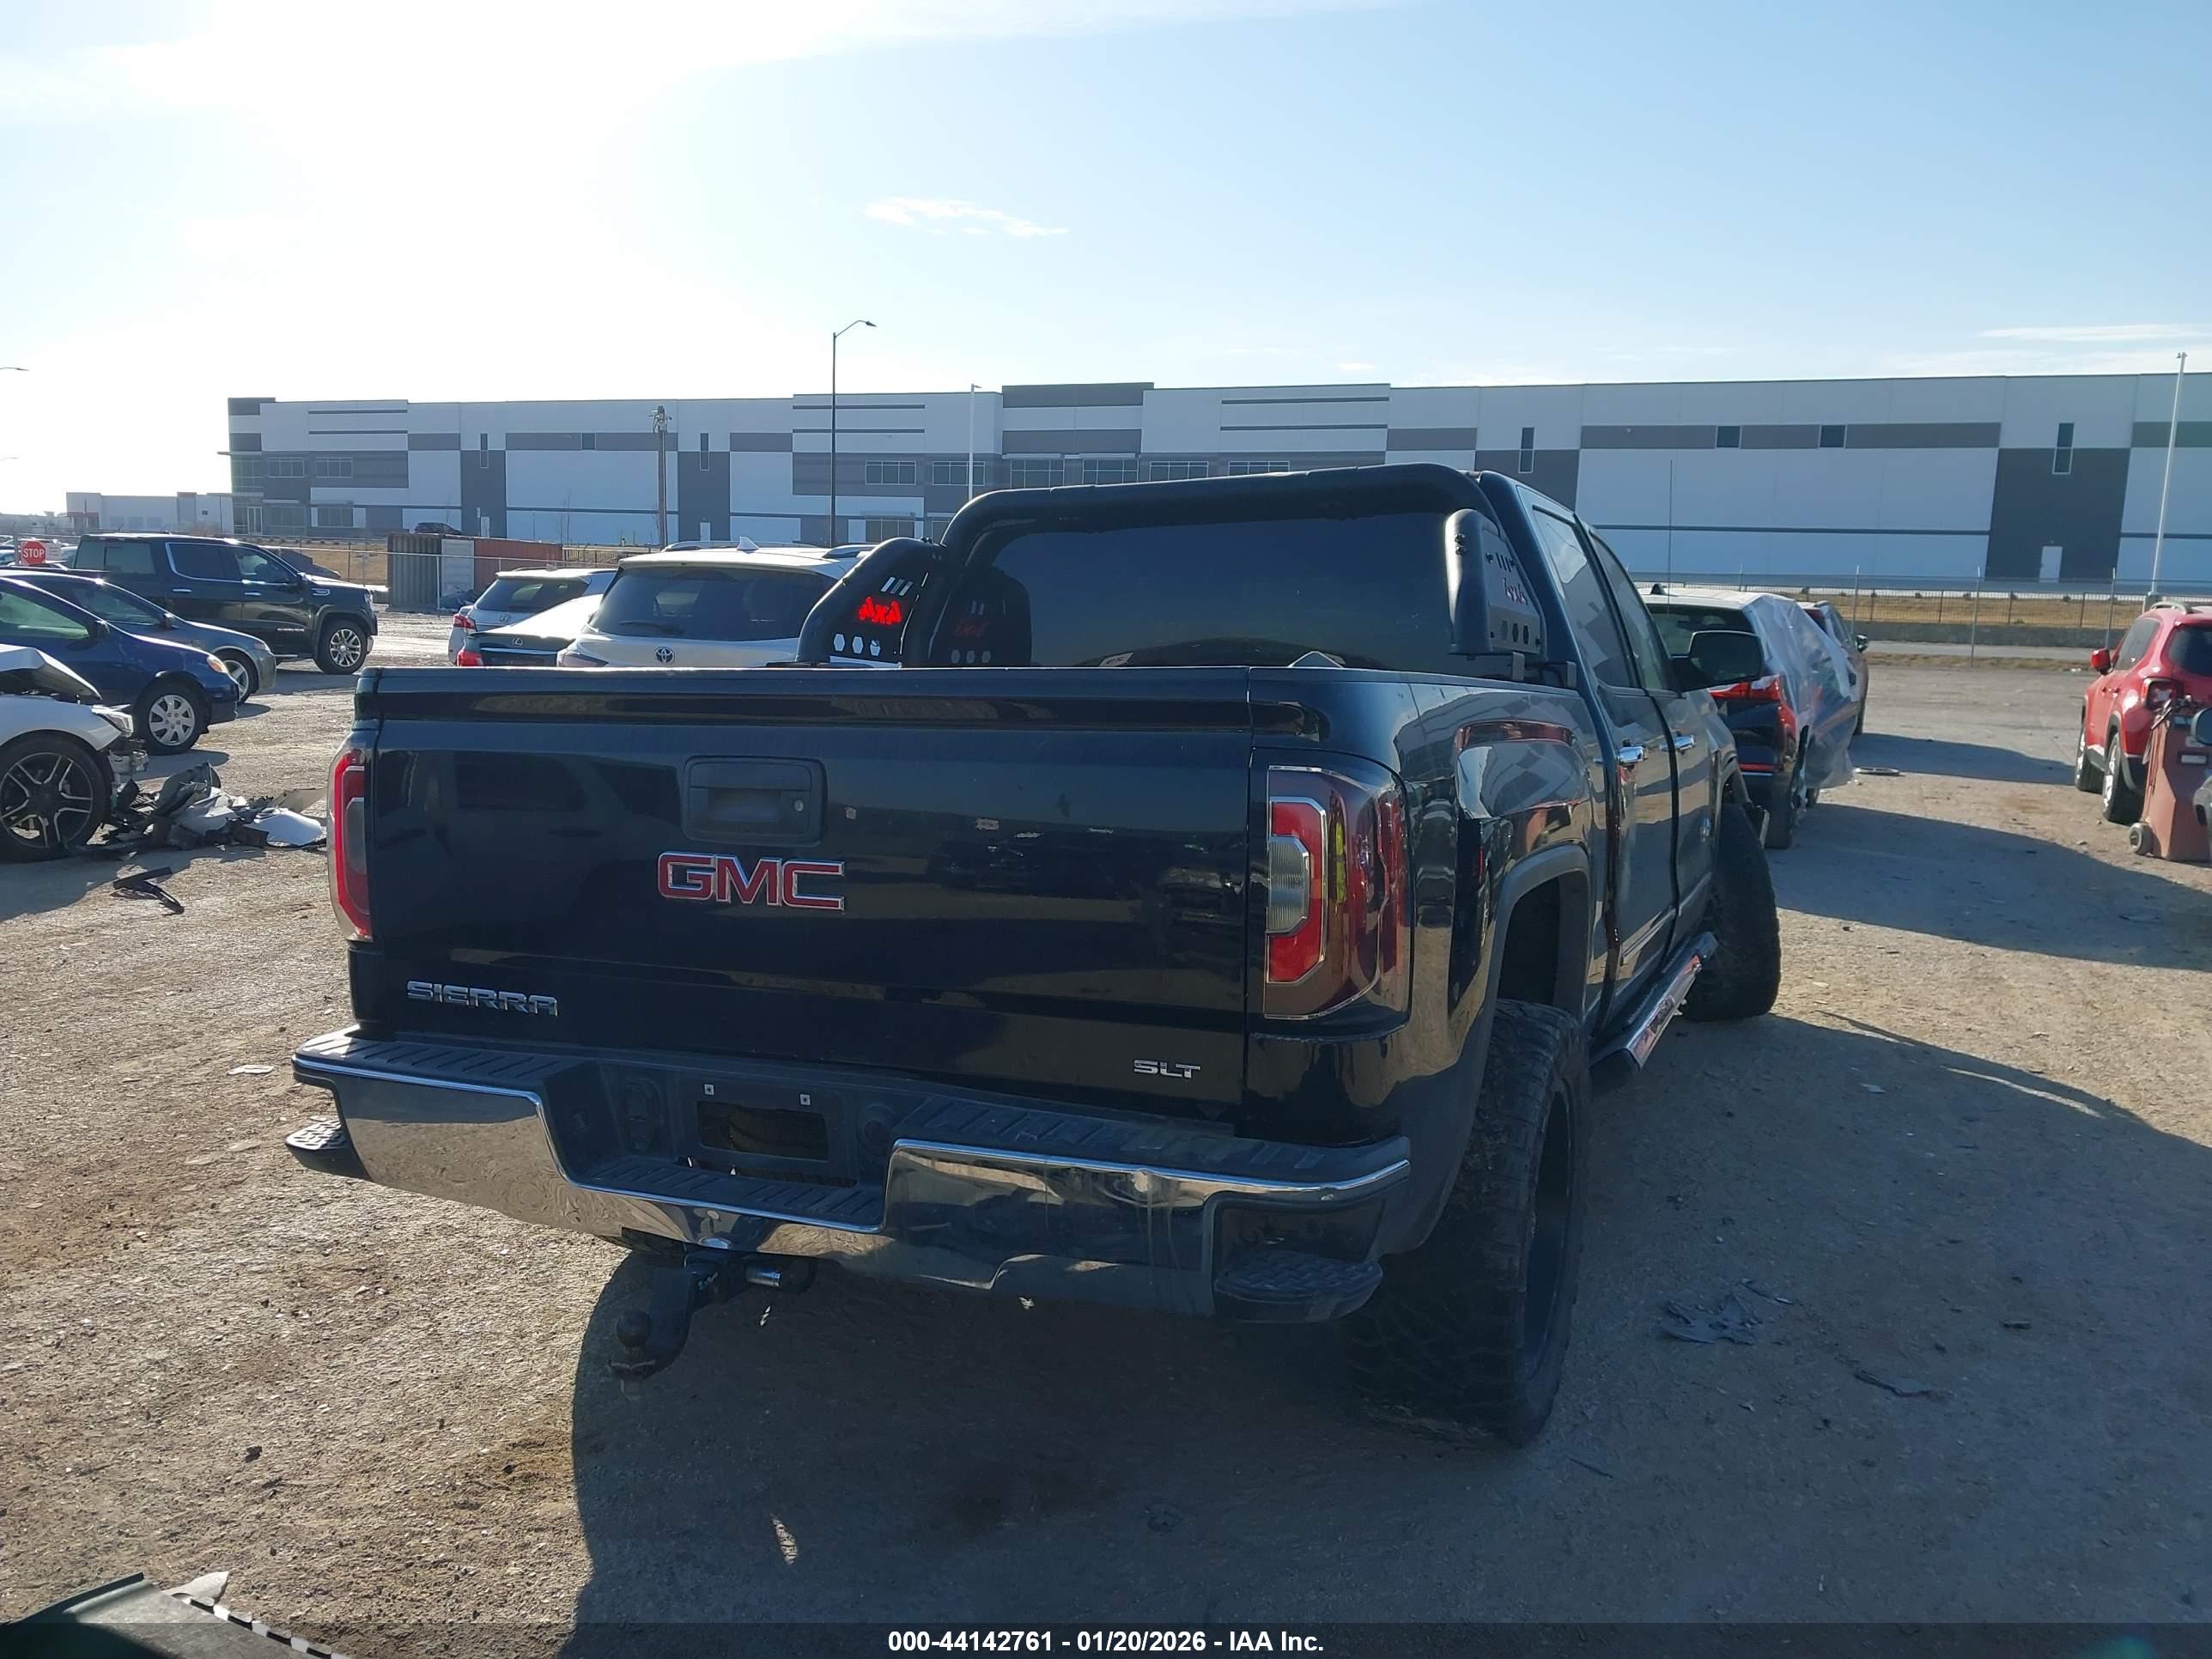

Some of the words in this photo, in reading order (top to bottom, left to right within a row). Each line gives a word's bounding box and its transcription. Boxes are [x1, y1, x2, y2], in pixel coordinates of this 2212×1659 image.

[22, 548, 45, 558] STOP
[658, 851, 845, 911] GMC
[406, 980, 559, 1018] SIERRA
[1133, 1058, 1202, 1079] SLT
